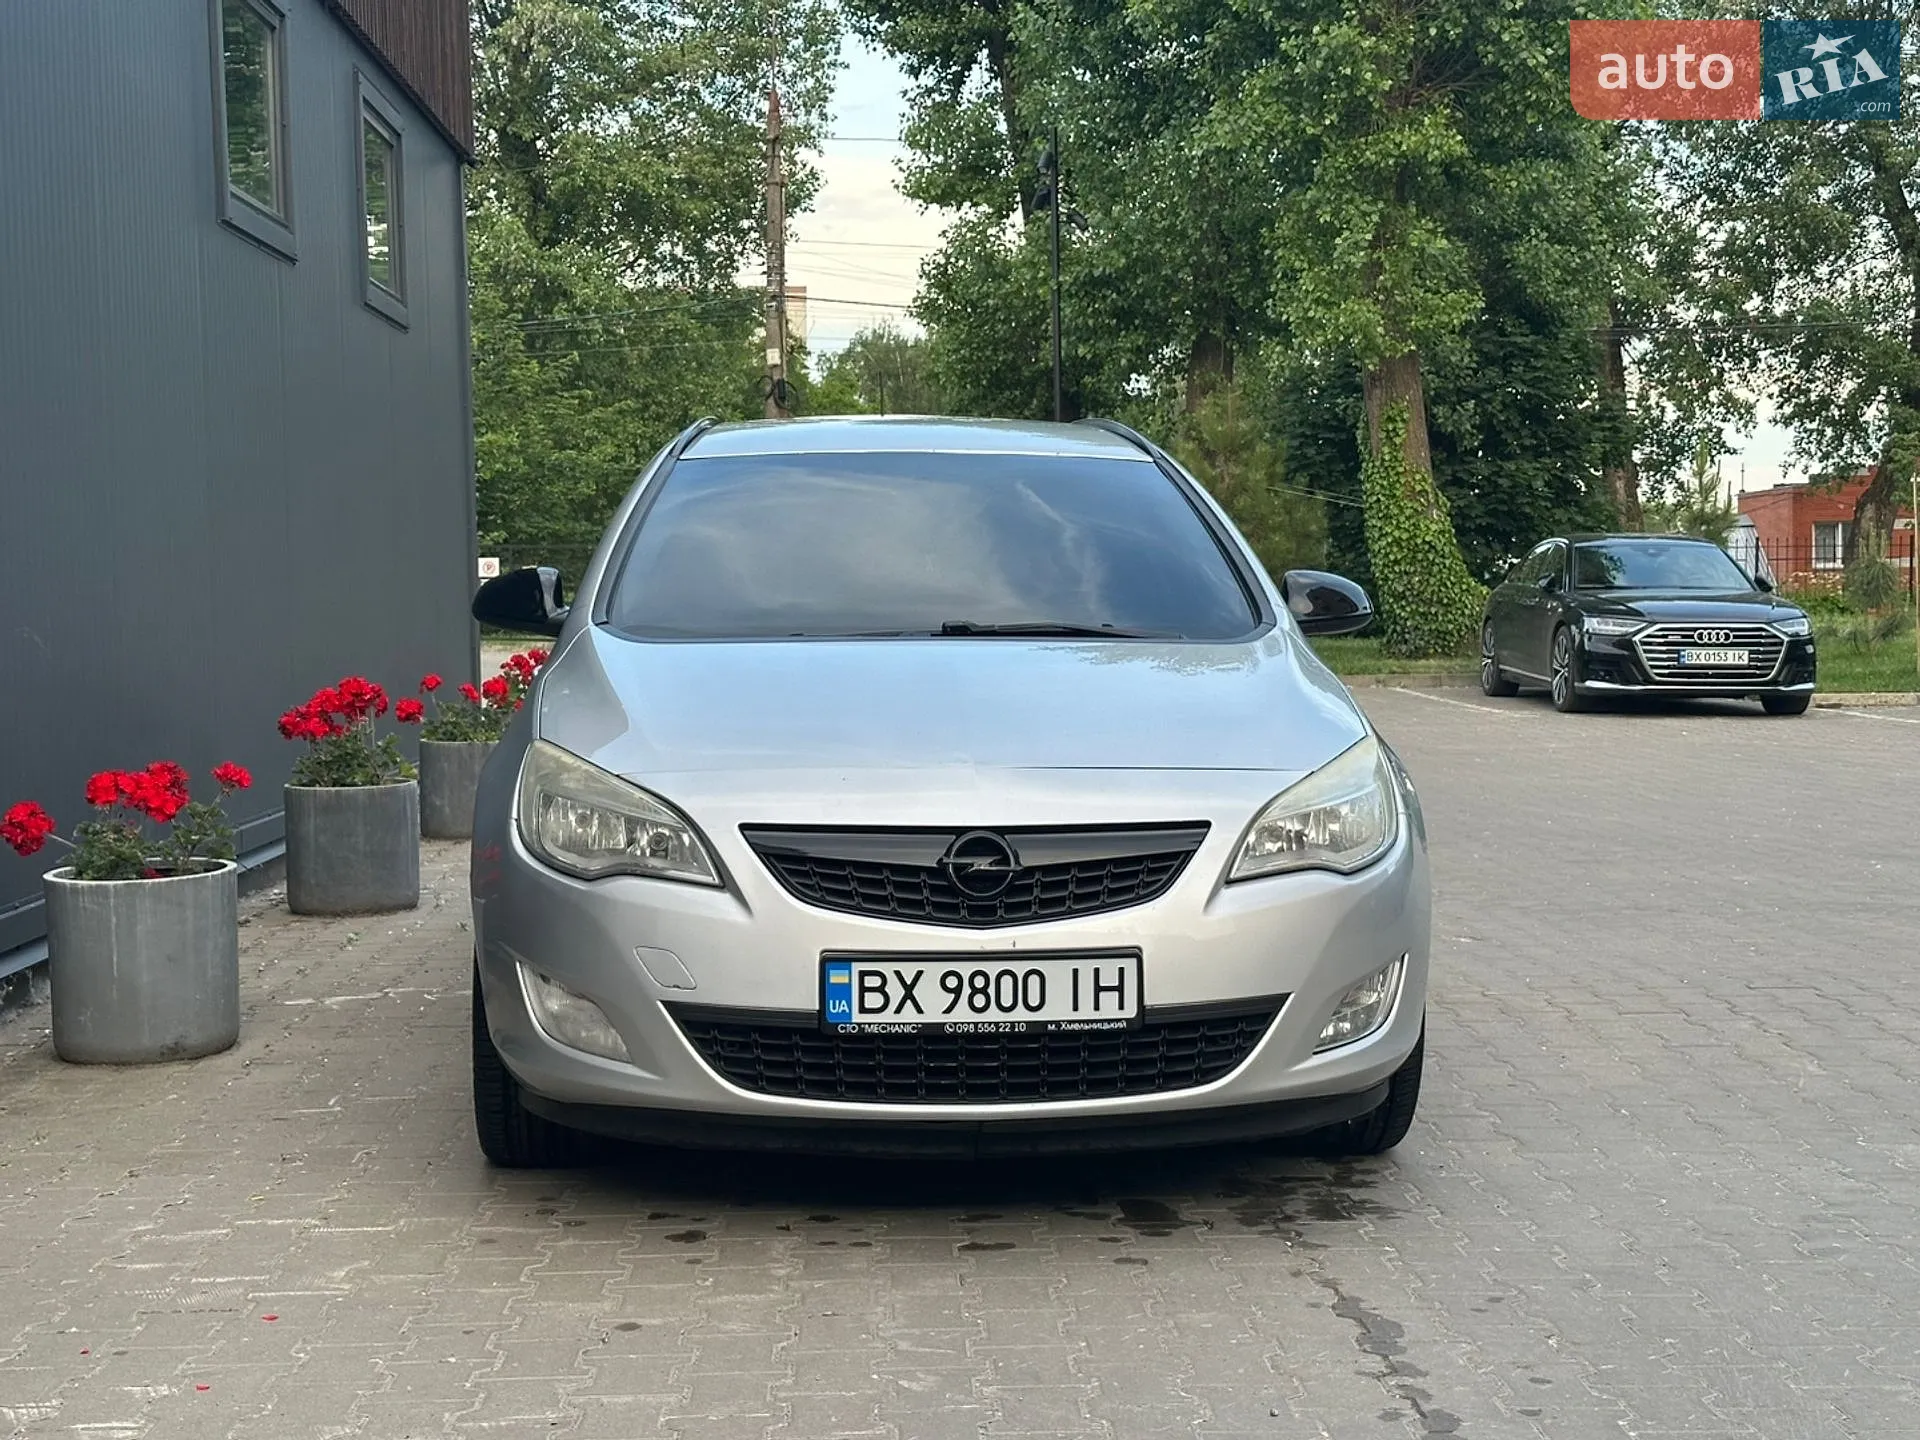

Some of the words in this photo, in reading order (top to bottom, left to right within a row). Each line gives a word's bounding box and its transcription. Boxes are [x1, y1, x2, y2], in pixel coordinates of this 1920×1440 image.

[1686, 651, 1702, 662] BX
[1704, 651, 1728, 662] 0153
[1733, 651, 1745, 662] IK
[858, 969, 924, 1015] BX
[939, 968, 1046, 1014] 9800
[1072, 966, 1125, 1012] IH
[829, 1000, 849, 1013] UA
[956, 1023, 974, 1032] 098
[977, 1023, 996, 1032] 556
[999, 1022, 1011, 1032] 22
[1014, 1022, 1027, 1032] 10
